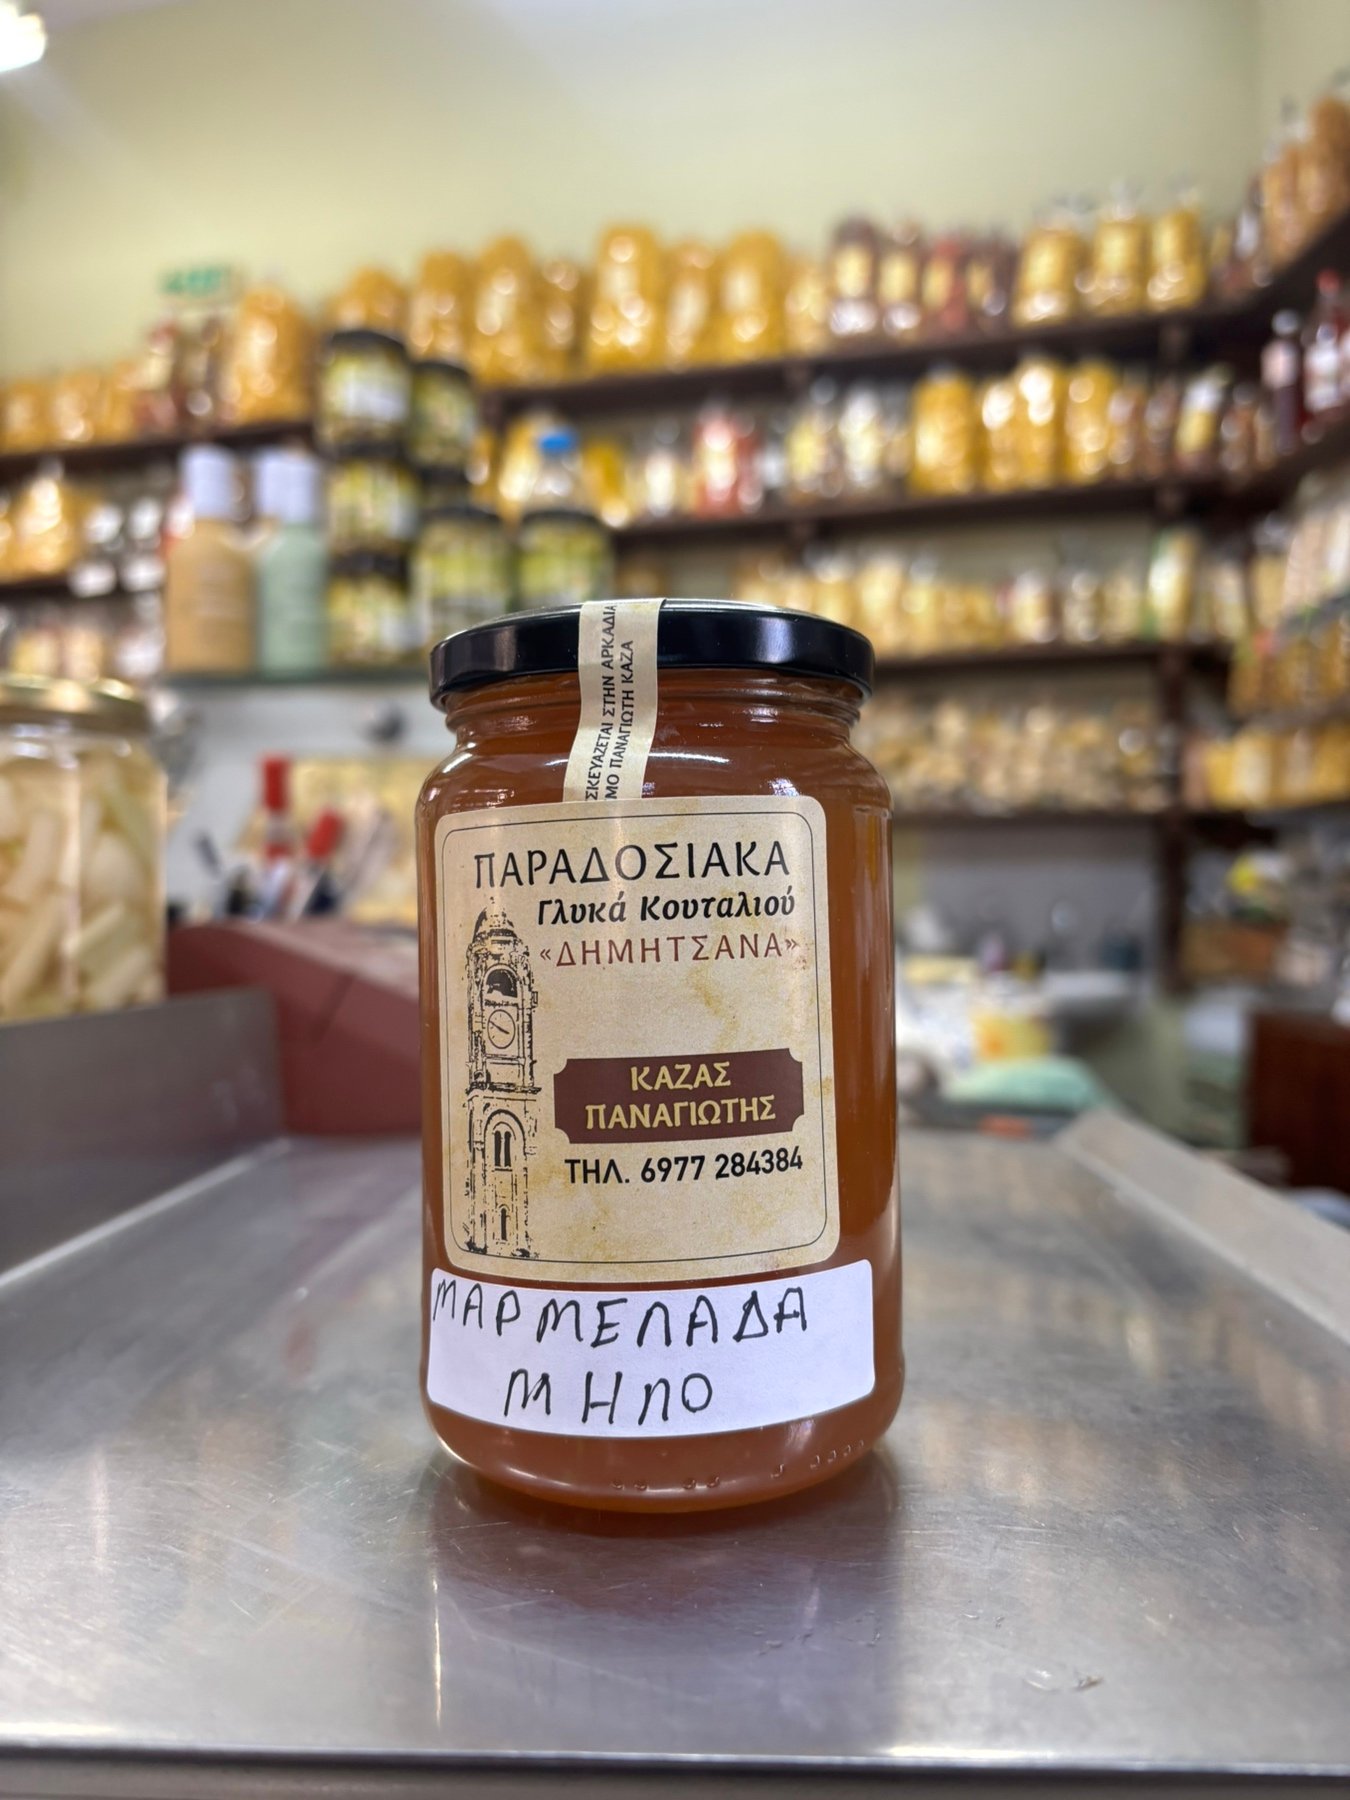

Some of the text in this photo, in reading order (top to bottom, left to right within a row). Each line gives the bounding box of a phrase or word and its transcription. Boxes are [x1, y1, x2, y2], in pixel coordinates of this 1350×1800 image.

[602, 675, 616, 717] ΣΤΗΝ
[604, 640, 635, 801] ΜΟ ΠΑΝΑΓΙΩΤΗ ΚΑΖΑ
[474, 840, 790, 889] ΠΑΡΑΔΟΣΙΑΚΑ
[537, 886, 796, 925] Γλυκά Κουταλιού
[540, 932, 798, 967] «ΔΗΜΗΤΣΑΝΑ»
[630, 1062, 732, 1092] ΚΑΖΑΣ
[585, 1095, 777, 1131] ΠΑΝΑΓΙΩΤΗΣ
[564, 1145, 803, 1184] ΤΗΛ. 6977 284384
